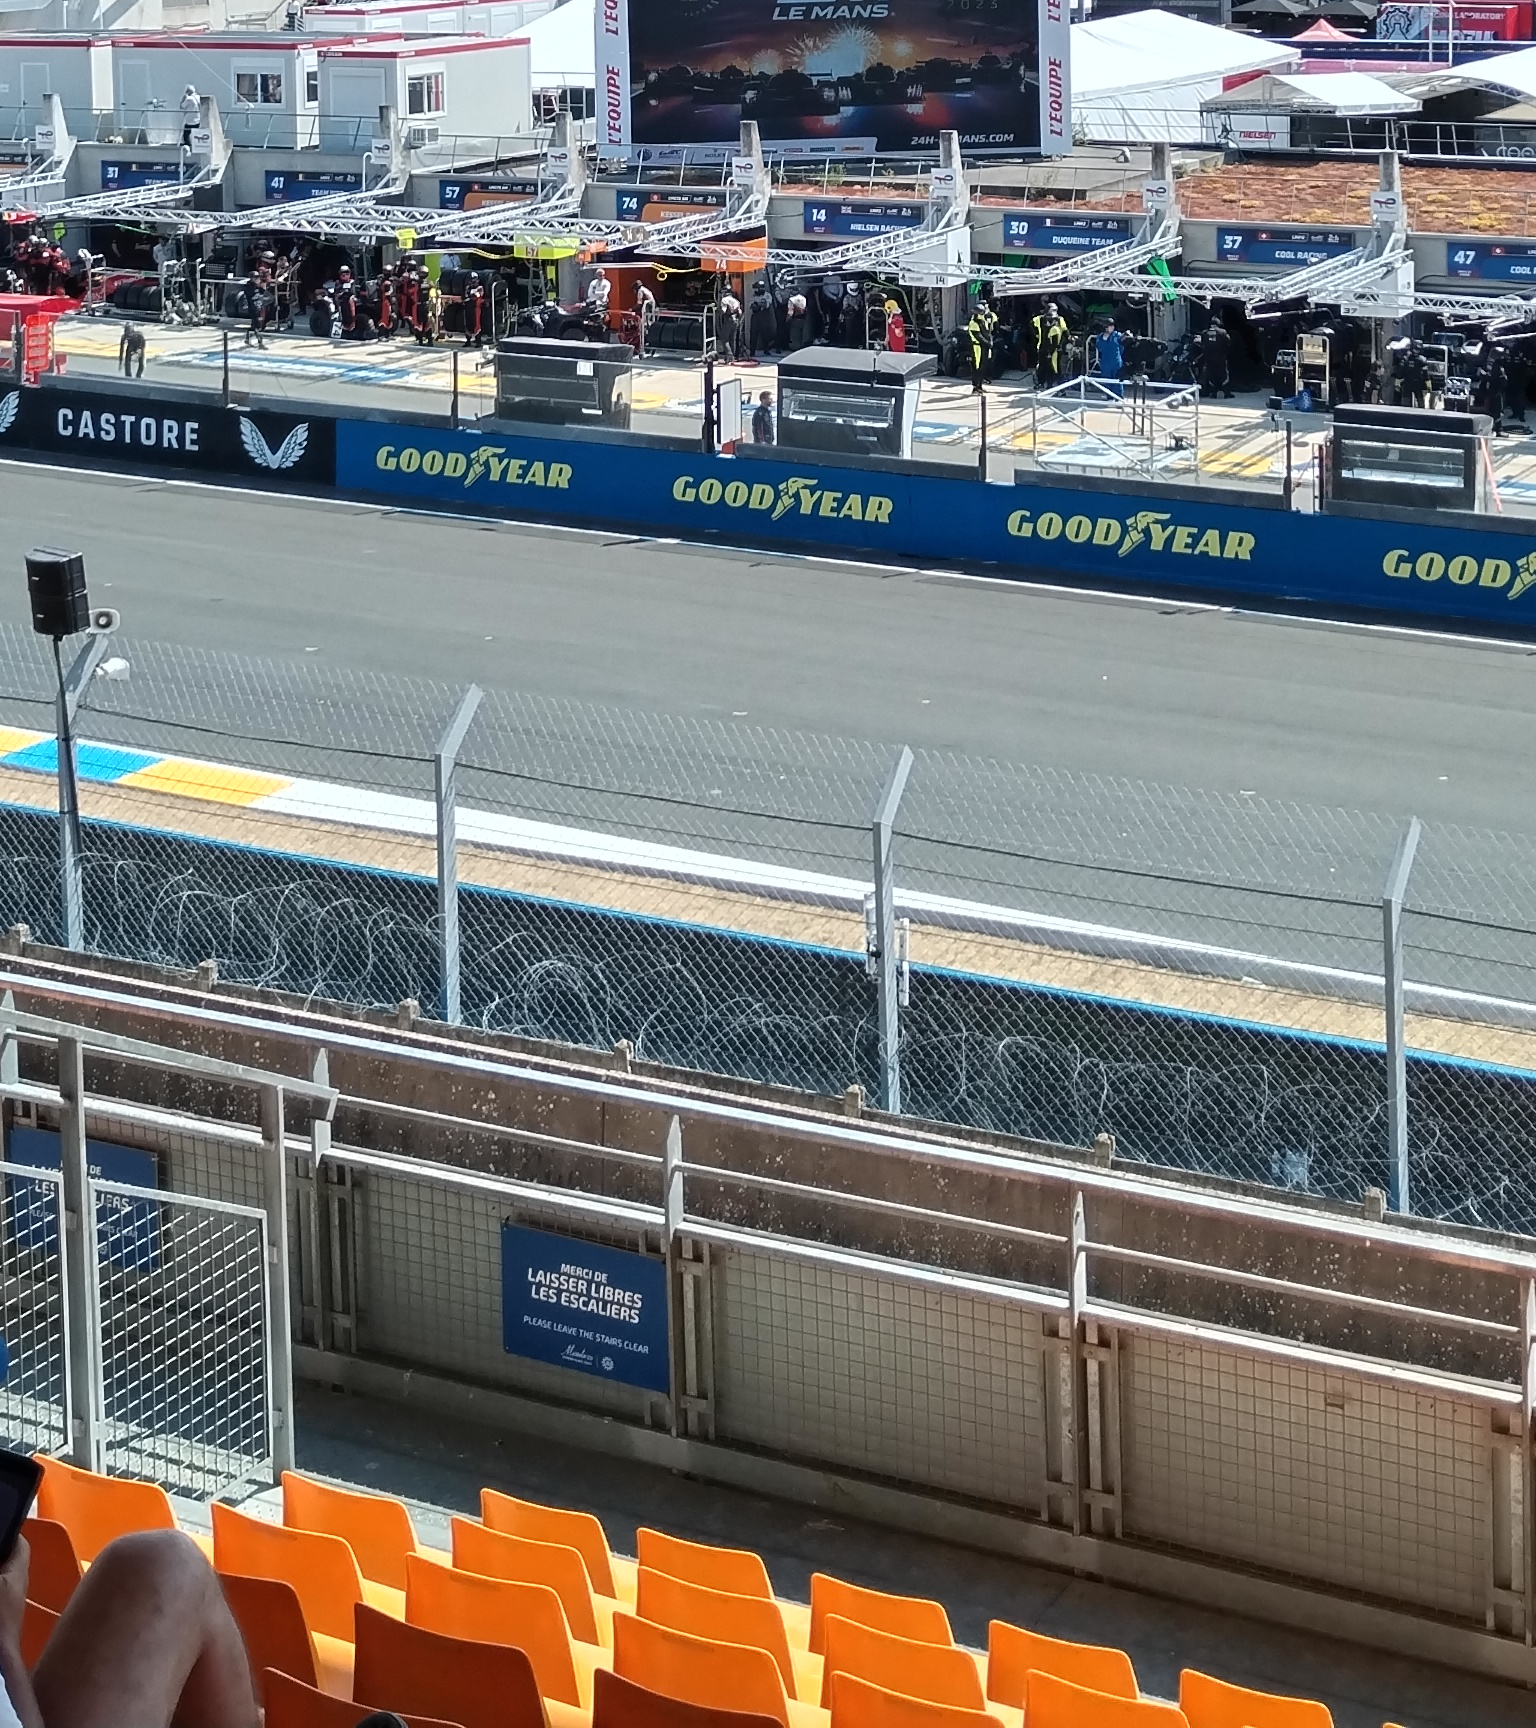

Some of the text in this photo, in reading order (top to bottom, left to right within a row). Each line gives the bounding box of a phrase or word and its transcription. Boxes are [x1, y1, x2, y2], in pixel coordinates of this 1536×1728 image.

[772, 4, 889, 21] LE MANS
[106, 167, 119, 178] 31
[271, 176, 284, 189] 41
[445, 186, 460, 199] 57
[622, 197, 638, 210] 74
[812, 209, 827, 222] 14
[850, 223, 880, 232] NIELSEN
[1010, 221, 1029, 235] 30
[359, 235, 377, 245] 41
[1052, 235, 1114, 246] DUQUEINE TEAM
[1223, 235, 1243, 249] 37
[526, 246, 539, 257] 57
[1275, 250, 1328, 260] COOL RACING
[1454, 250, 1476, 265] 47
[715, 259, 727, 270] 74
[1510, 266, 1531, 275] COOL
[935, 275, 945, 285] 14
[1149, 291, 1163, 302] 30
[1343, 307, 1358, 315] 37
[57, 407, 201, 452] CASTORE
[89, 1164, 102, 1175] DE
[561, 1263, 608, 1284] MERCI DE
[527, 1268, 643, 1309] LAISSER LIBRES
[531, 1285, 640, 1324] LES ESCALIERS
[523, 1315, 649, 1354] PLEASE LEAVE THE STAIRS CLEAR
